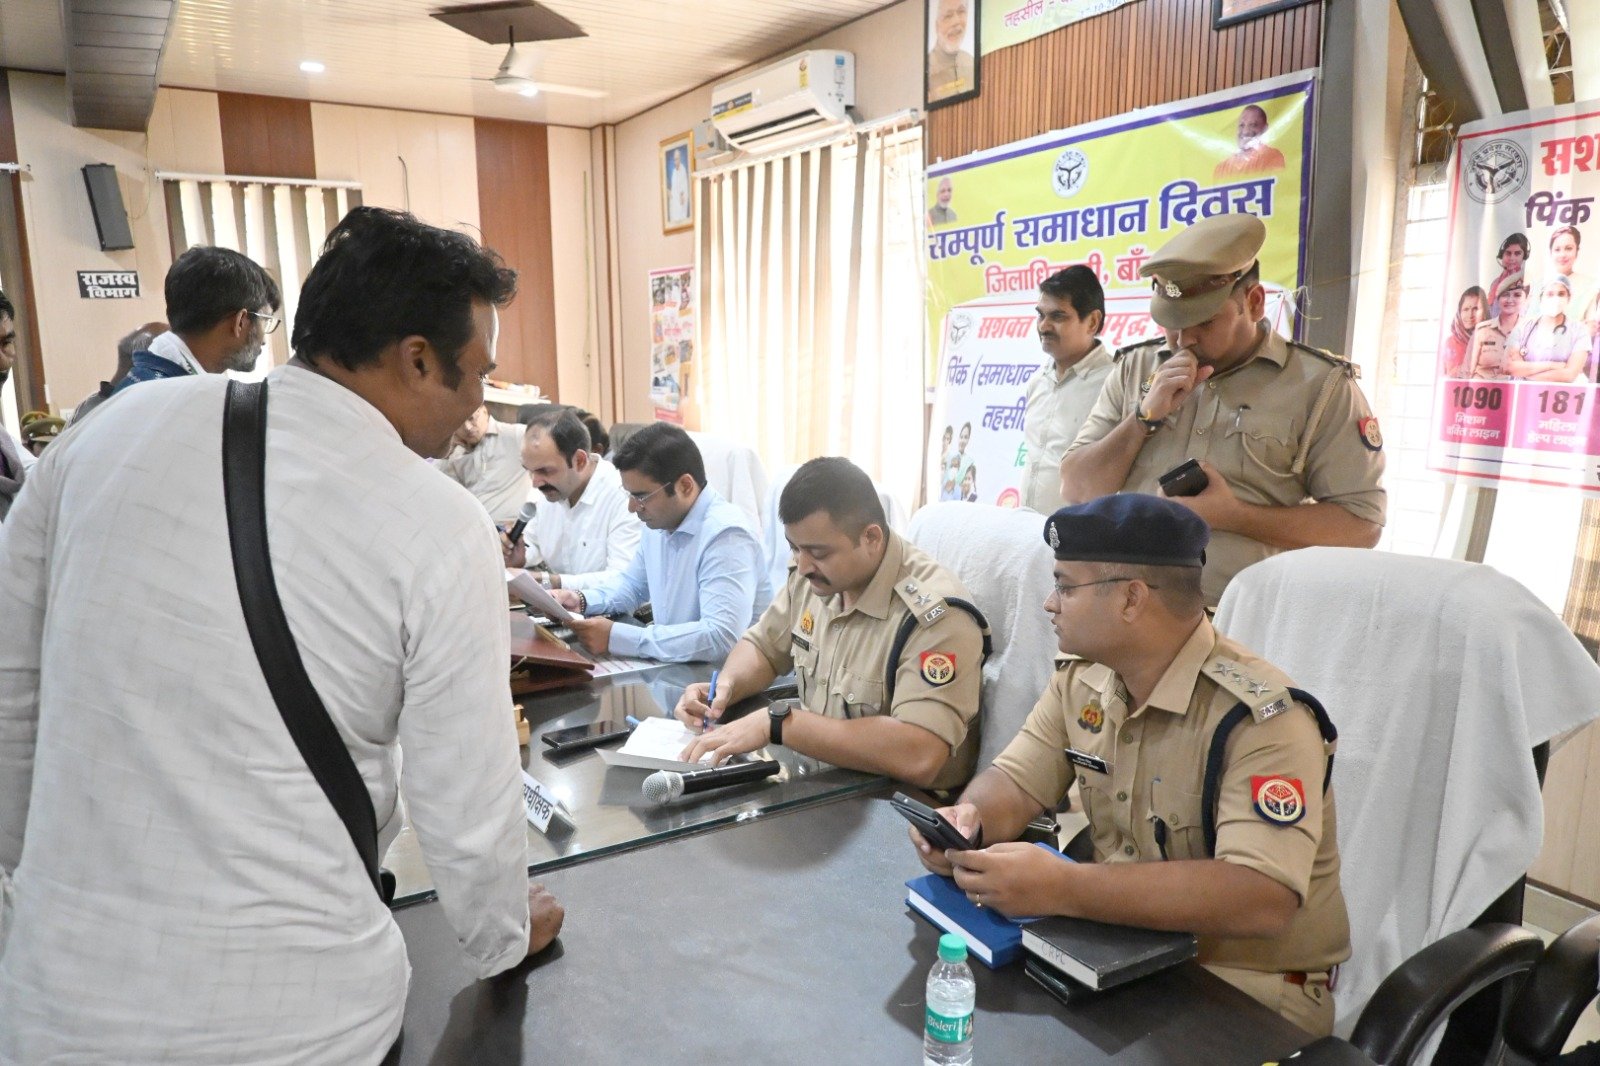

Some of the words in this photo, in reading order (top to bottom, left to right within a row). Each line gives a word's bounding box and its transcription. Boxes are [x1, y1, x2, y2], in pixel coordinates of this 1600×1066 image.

[1541, 133, 1600, 176] सश
[928, 212, 1006, 265] सम्पूर्ण
[1013, 199, 1149, 248] समाधान
[1159, 178, 1275, 230] दिवस
[1525, 191, 1594, 228] पिंक
[978, 315, 1037, 338] सशक्त
[982, 396, 1026, 431] तहसी
[1453, 386, 1503, 411] 1090
[1538, 390, 1586, 415] 181
[927, 1014, 957, 1032] Bisleri
